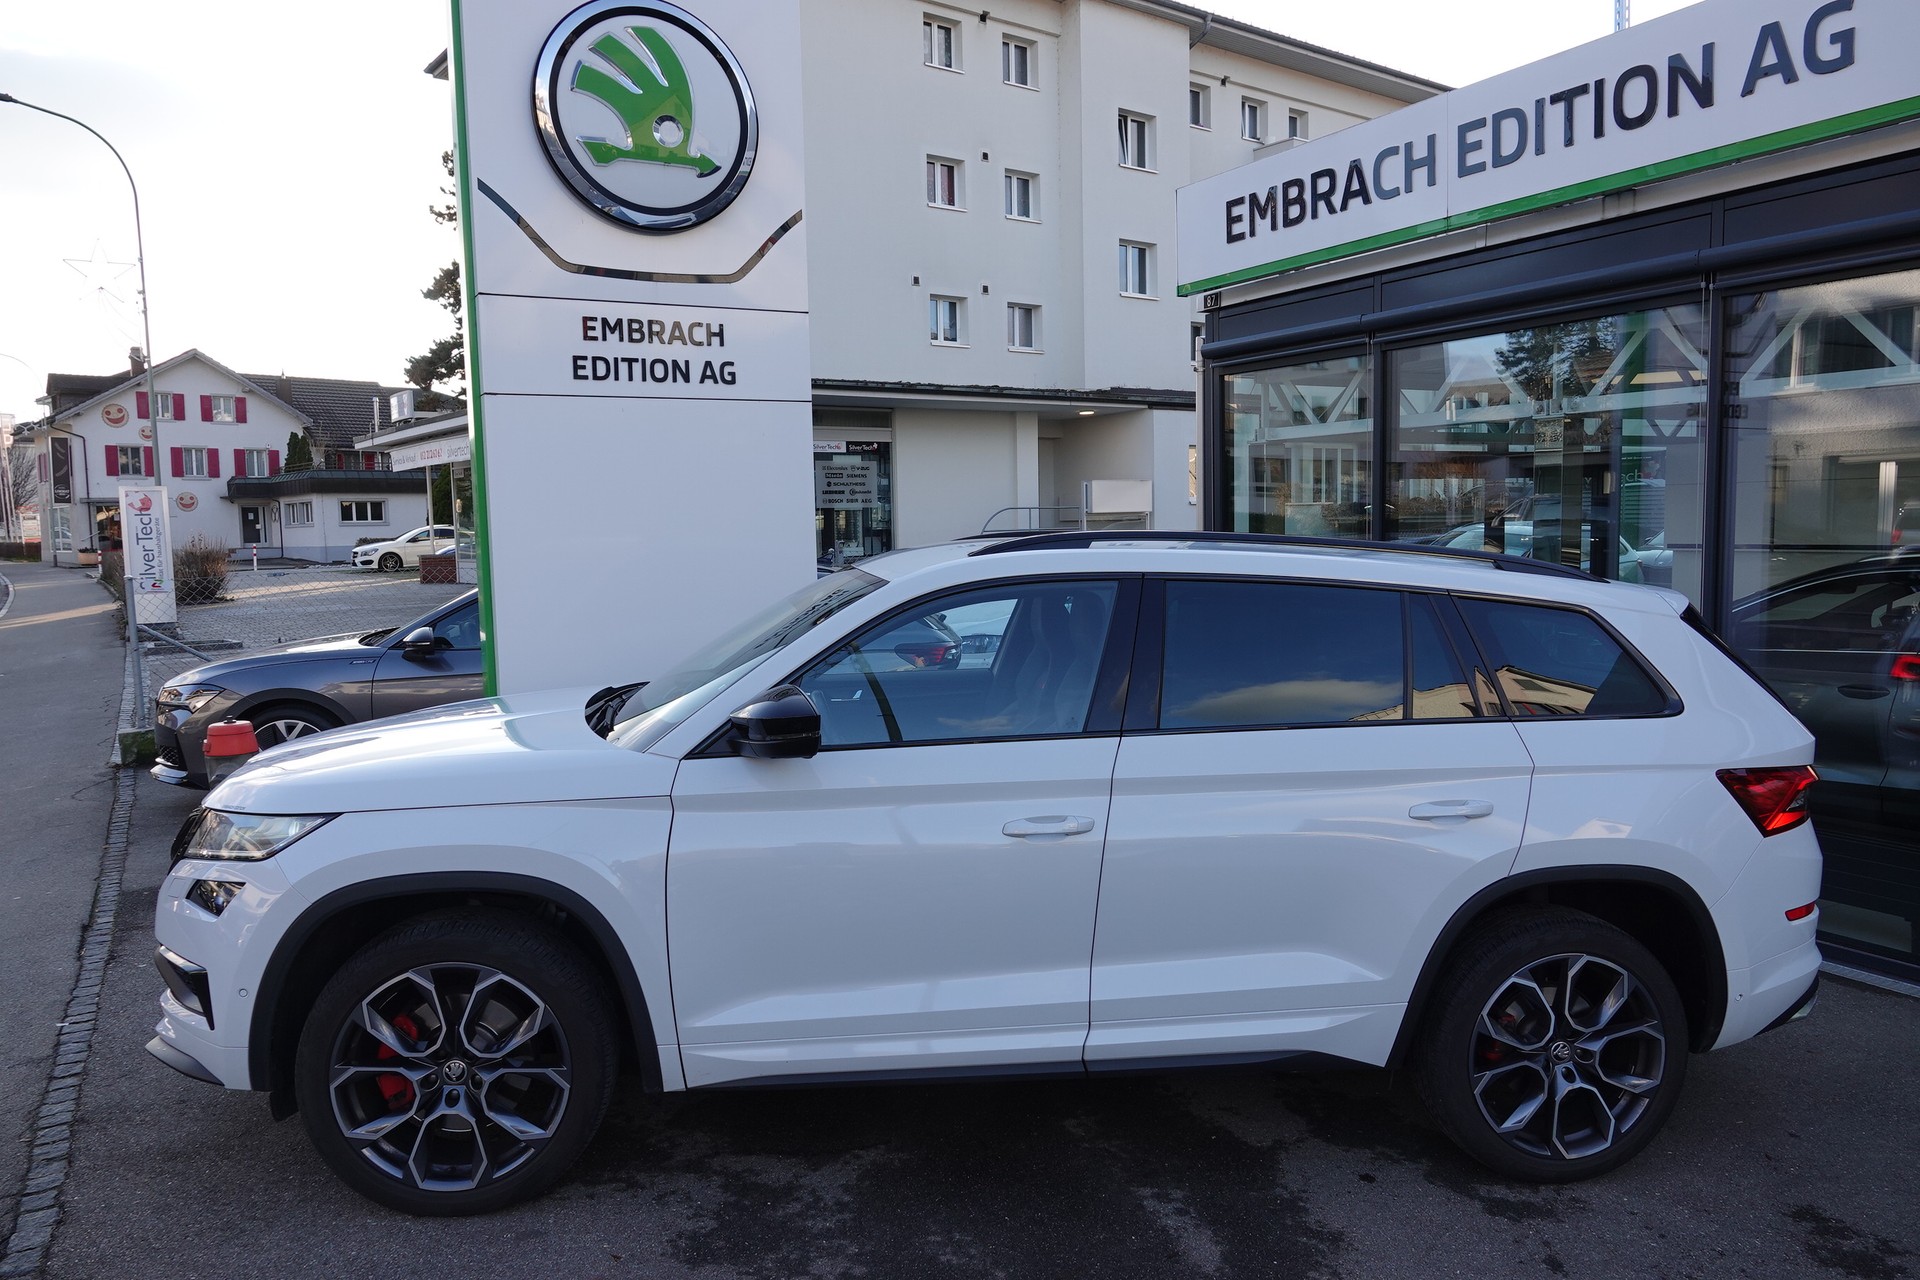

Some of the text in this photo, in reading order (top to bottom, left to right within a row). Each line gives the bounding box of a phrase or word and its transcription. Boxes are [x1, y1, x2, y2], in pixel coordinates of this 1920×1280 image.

[1225, 0, 1856, 245] EMBRACH EDITION AG
[1206, 294, 1216, 307] 87
[582, 316, 725, 347] EMBRACH
[572, 355, 737, 386] EDITION AG
